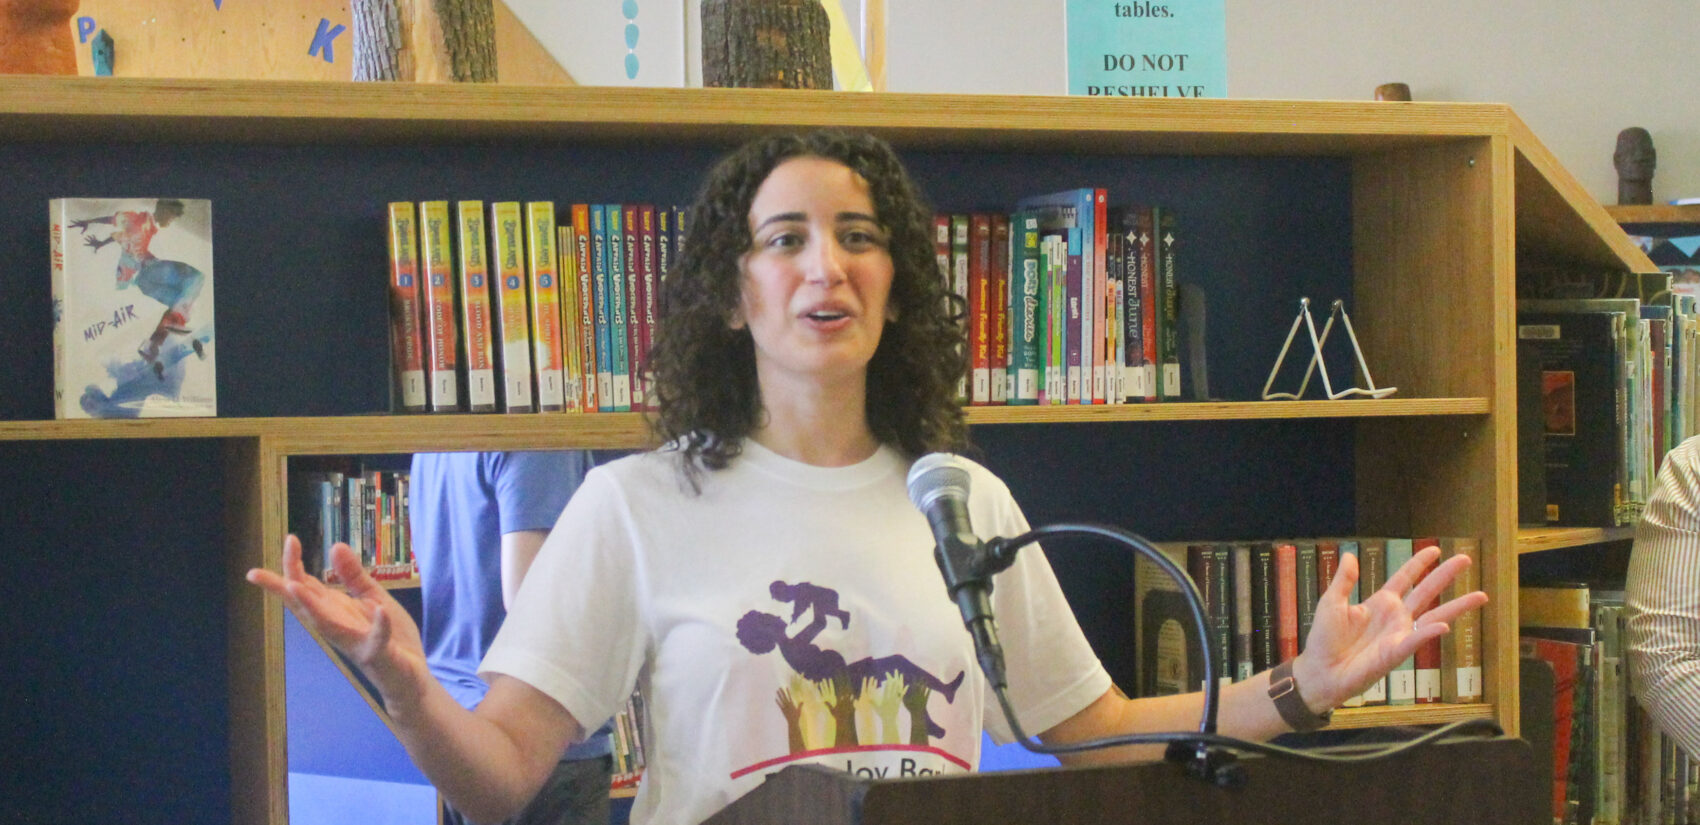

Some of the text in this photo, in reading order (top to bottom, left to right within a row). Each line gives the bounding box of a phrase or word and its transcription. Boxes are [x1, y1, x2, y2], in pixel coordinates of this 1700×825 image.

[1114, 1, 1174, 18] tables.
[77, 16, 96, 44] P
[308, 17, 347, 64] K
[1103, 54, 1189, 71] DO NOT
[541, 275, 549, 285] 5
[1126, 252, 1137, 298] HONEST
[1465, 627, 1473, 649] THE
